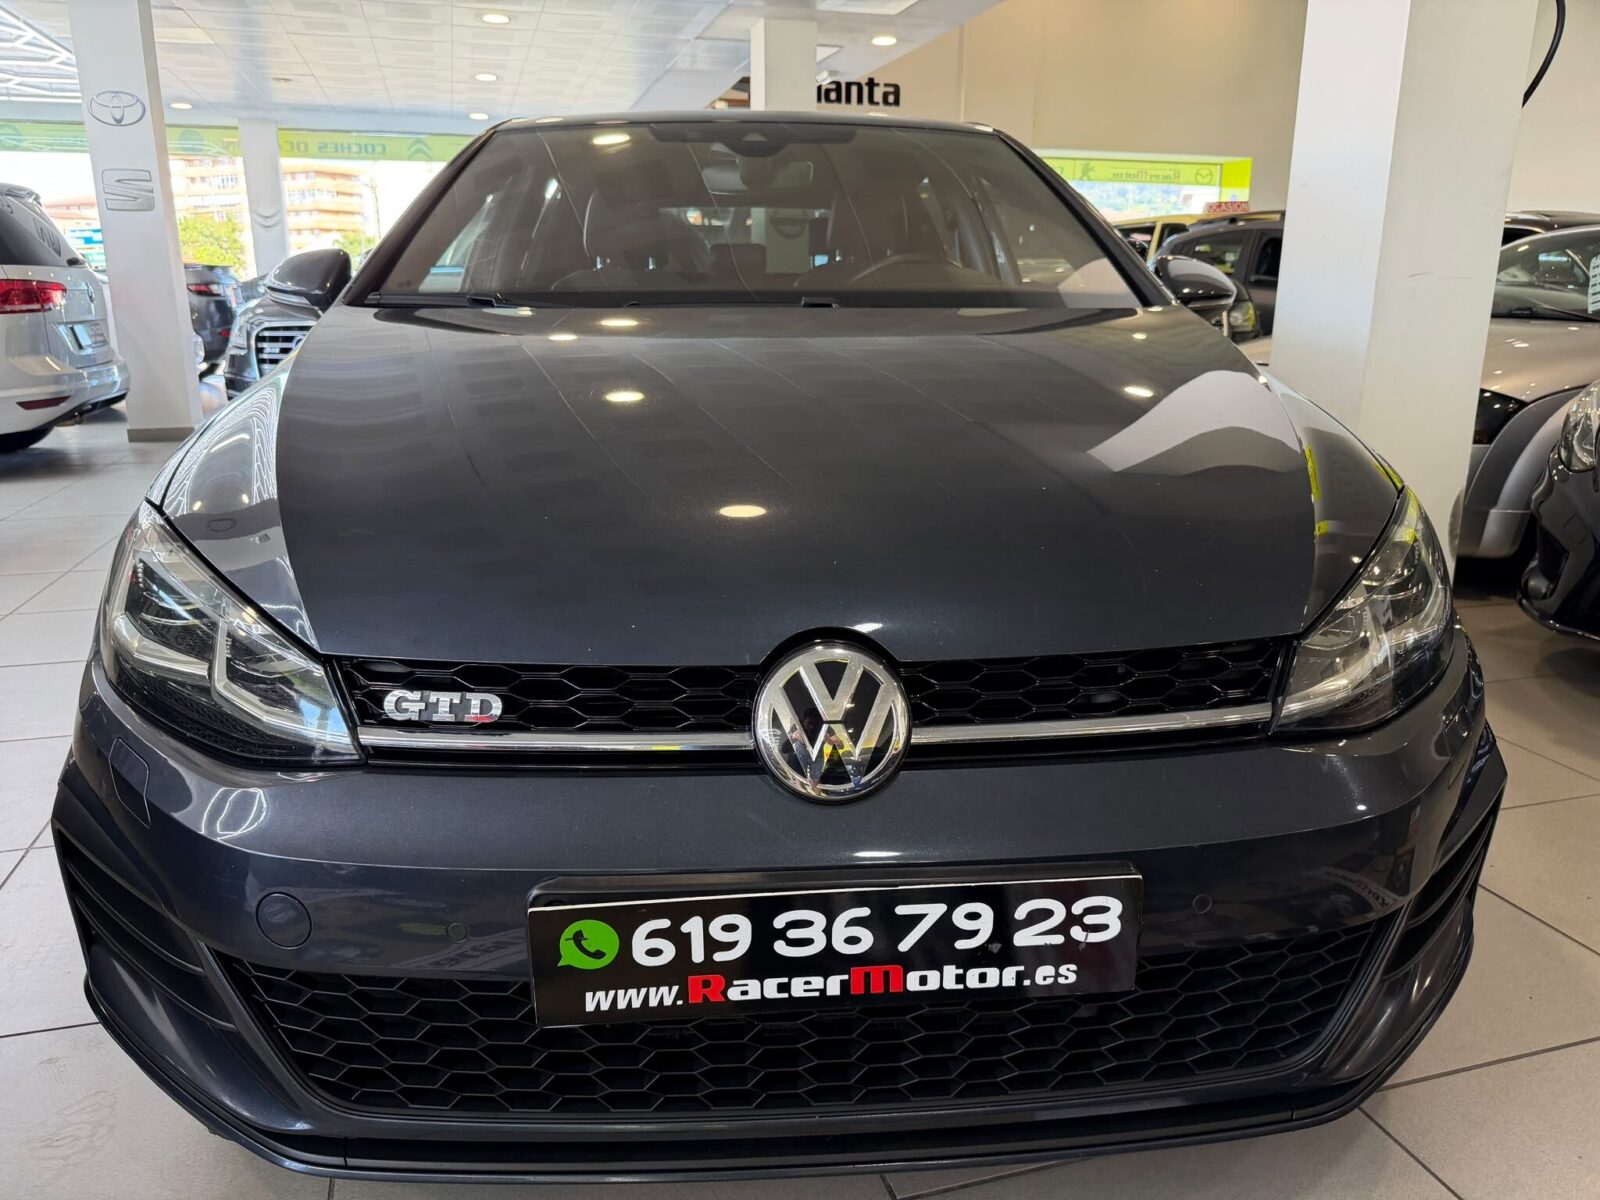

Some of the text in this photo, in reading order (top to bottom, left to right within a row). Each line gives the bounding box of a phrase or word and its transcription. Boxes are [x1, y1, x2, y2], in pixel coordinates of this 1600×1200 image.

[383, 689, 503, 723] GTD
[631, 895, 1124, 968] 619 36 79 23
[585, 962, 1077, 1012] www.RacerMotor.es
